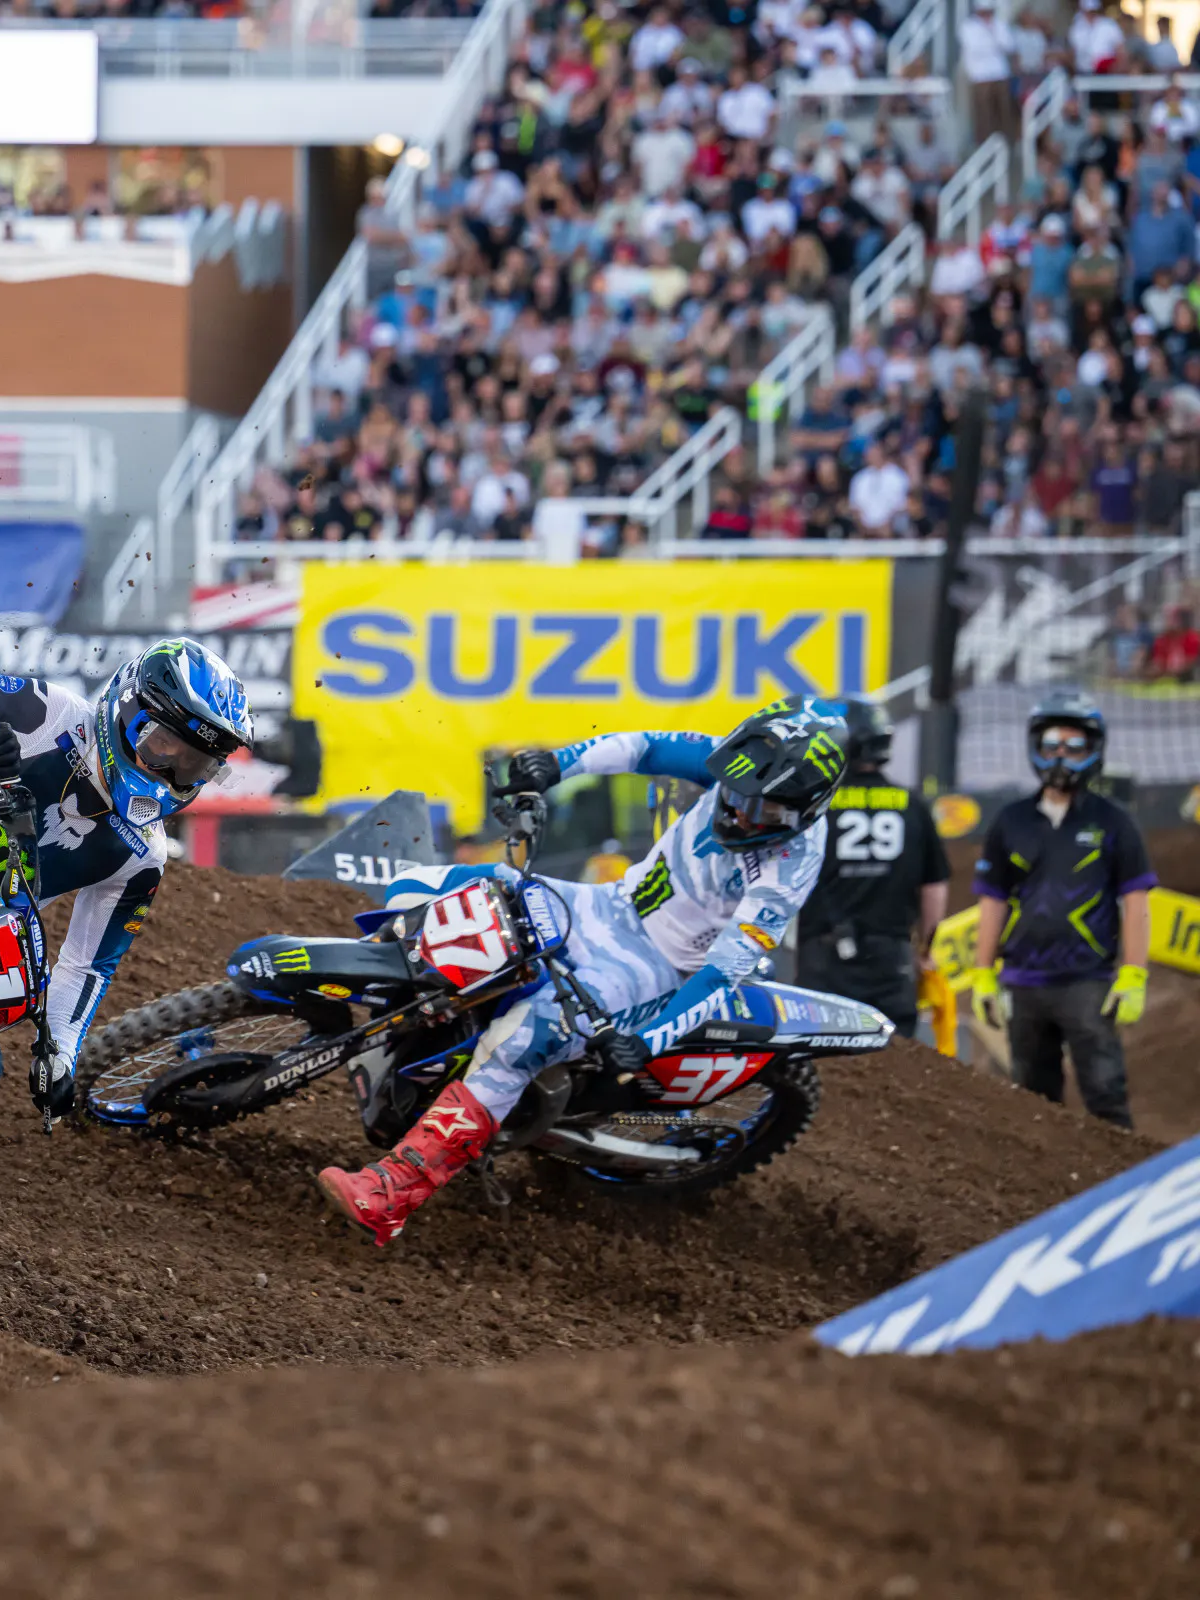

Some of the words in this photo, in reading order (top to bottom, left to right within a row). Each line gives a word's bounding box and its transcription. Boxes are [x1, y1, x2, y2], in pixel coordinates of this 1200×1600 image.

[319, 610, 867, 699] SUZUKI
[117, 822, 145, 856] YAMAHA
[836, 810, 905, 861] 29
[334, 853, 392, 885] 5.11
[423, 887, 508, 974] 37
[808, 1034, 873, 1049] DUNLOP
[263, 1045, 347, 1092] DUNLOP
[660, 1056, 748, 1103] 37
